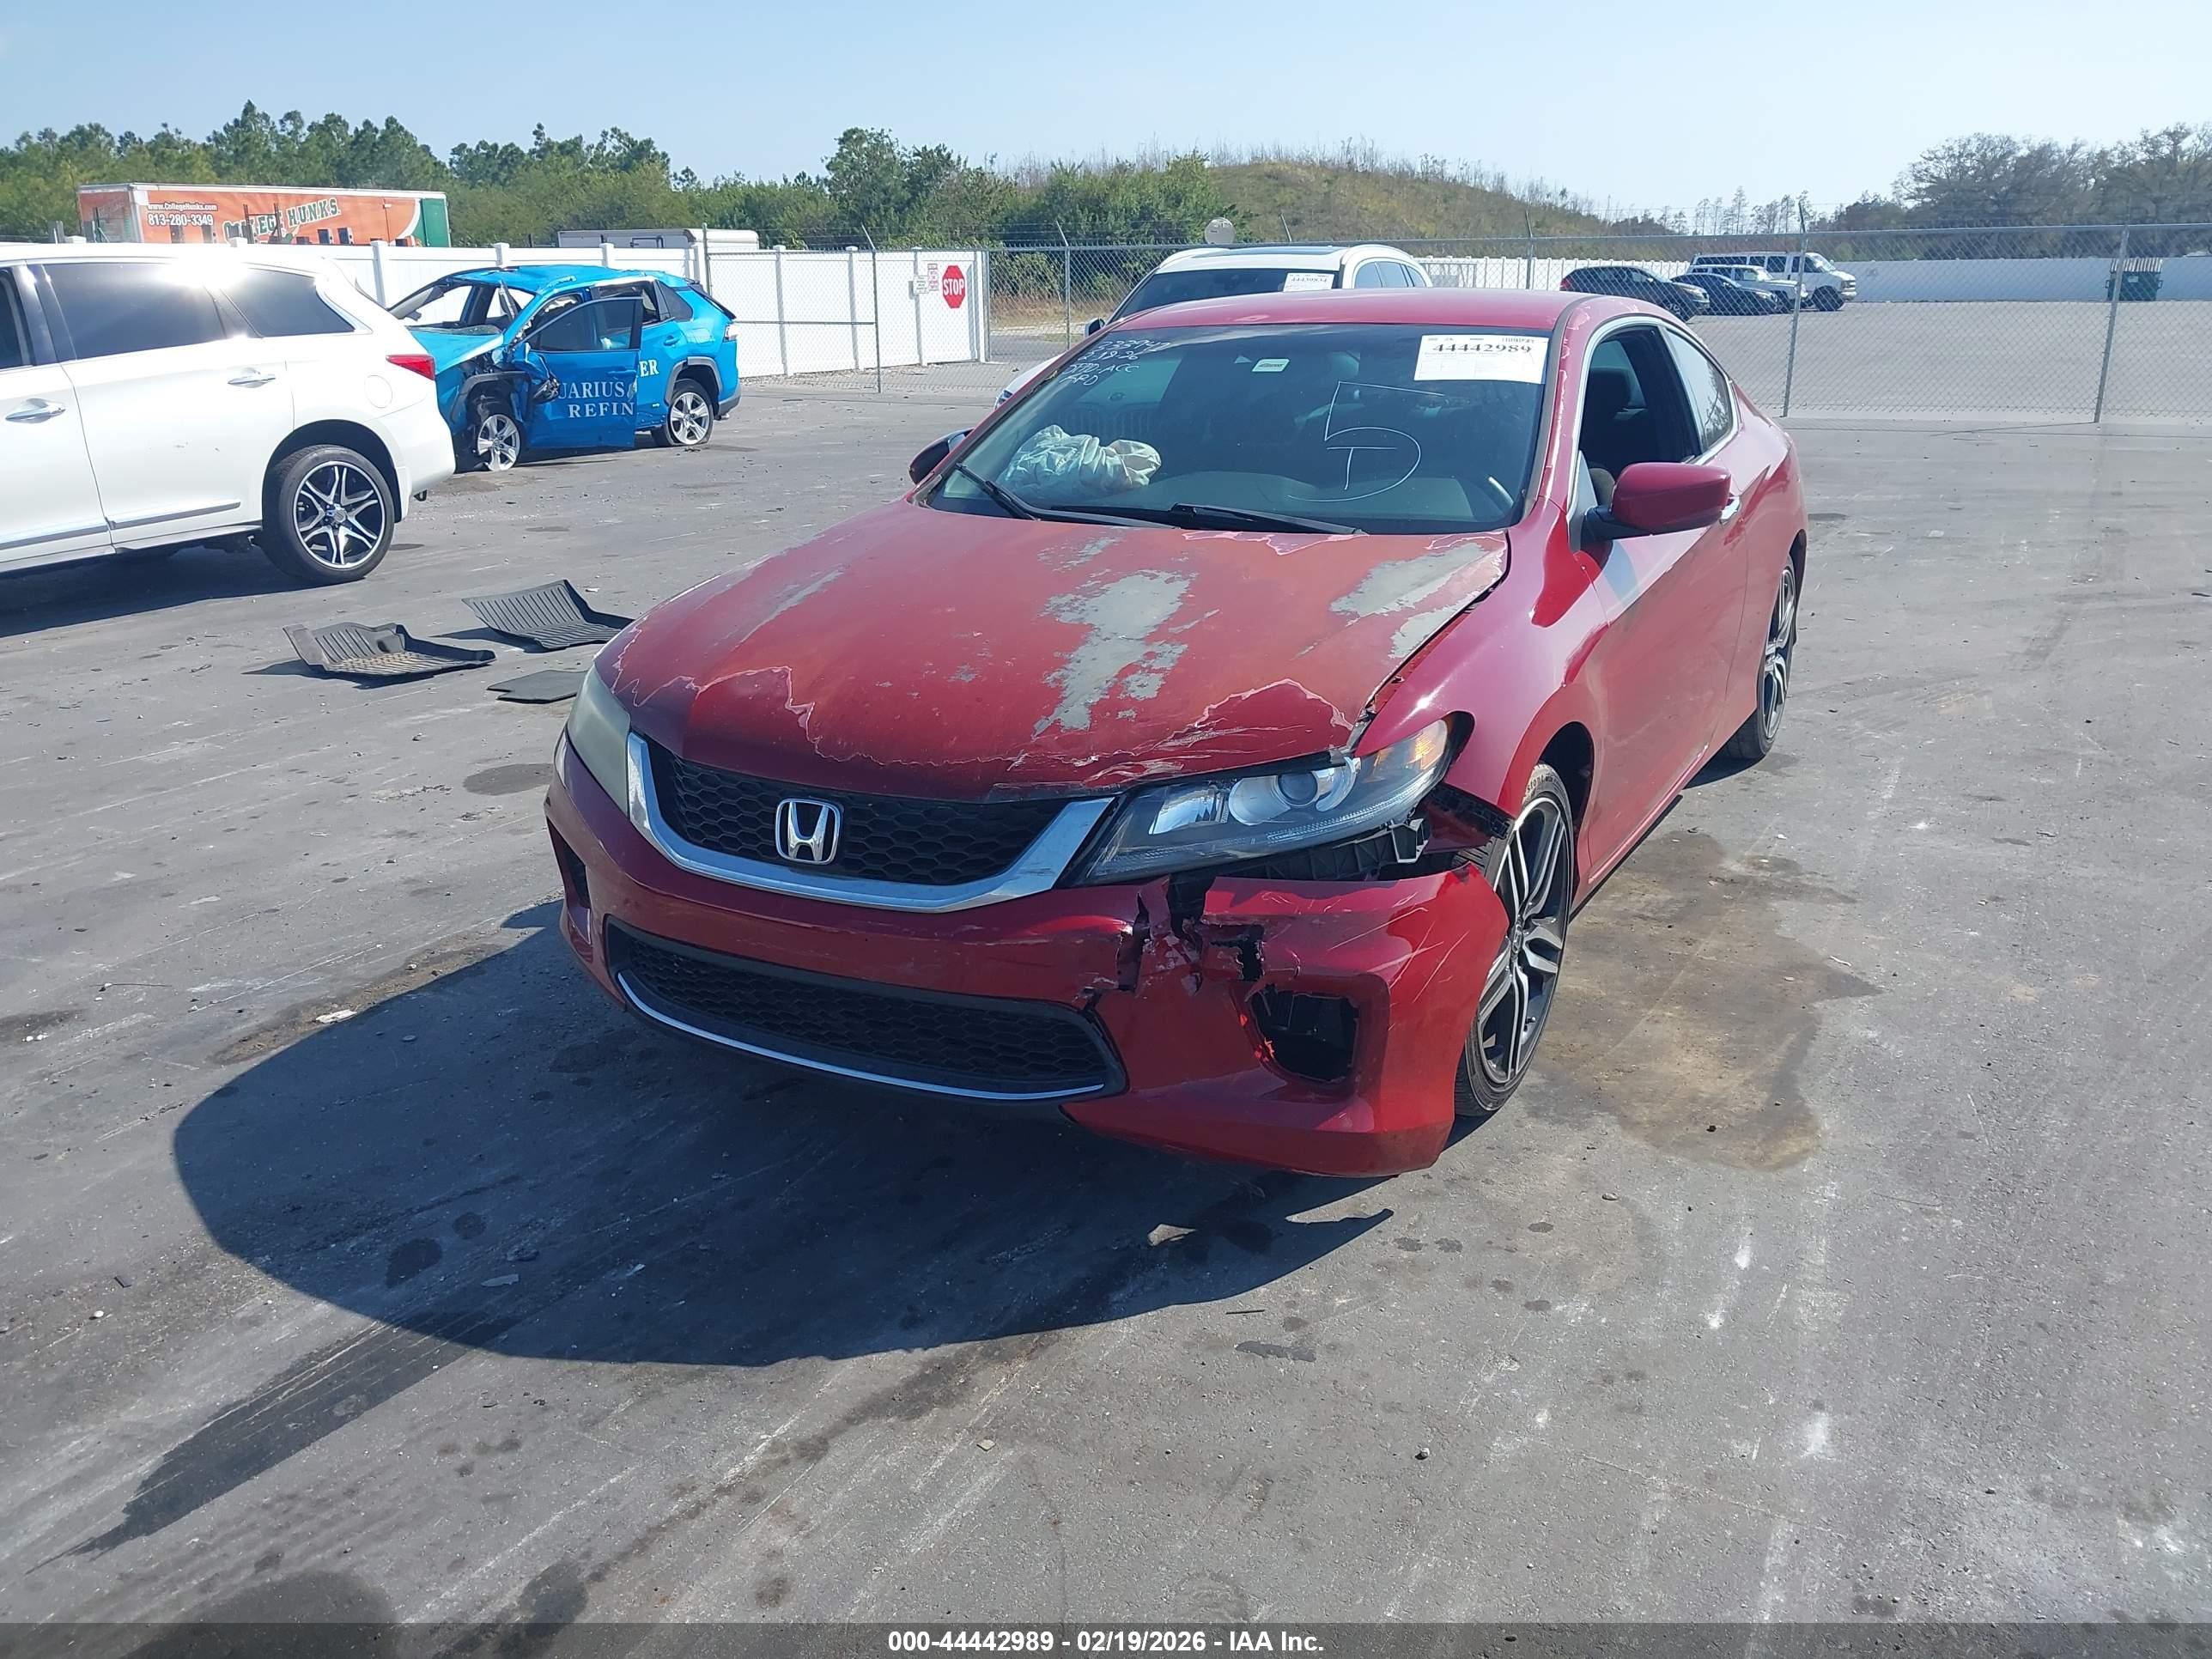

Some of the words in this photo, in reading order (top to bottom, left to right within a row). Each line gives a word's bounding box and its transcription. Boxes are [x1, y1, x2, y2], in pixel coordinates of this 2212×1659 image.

[148, 213, 214, 226] 813-280-3349
[943, 277, 964, 296] STOP
[1432, 343, 1533, 354] 44442989
[639, 359, 659, 378] ER
[568, 402, 635, 419] REFIN
[1287, 380, 1446, 502] 5
